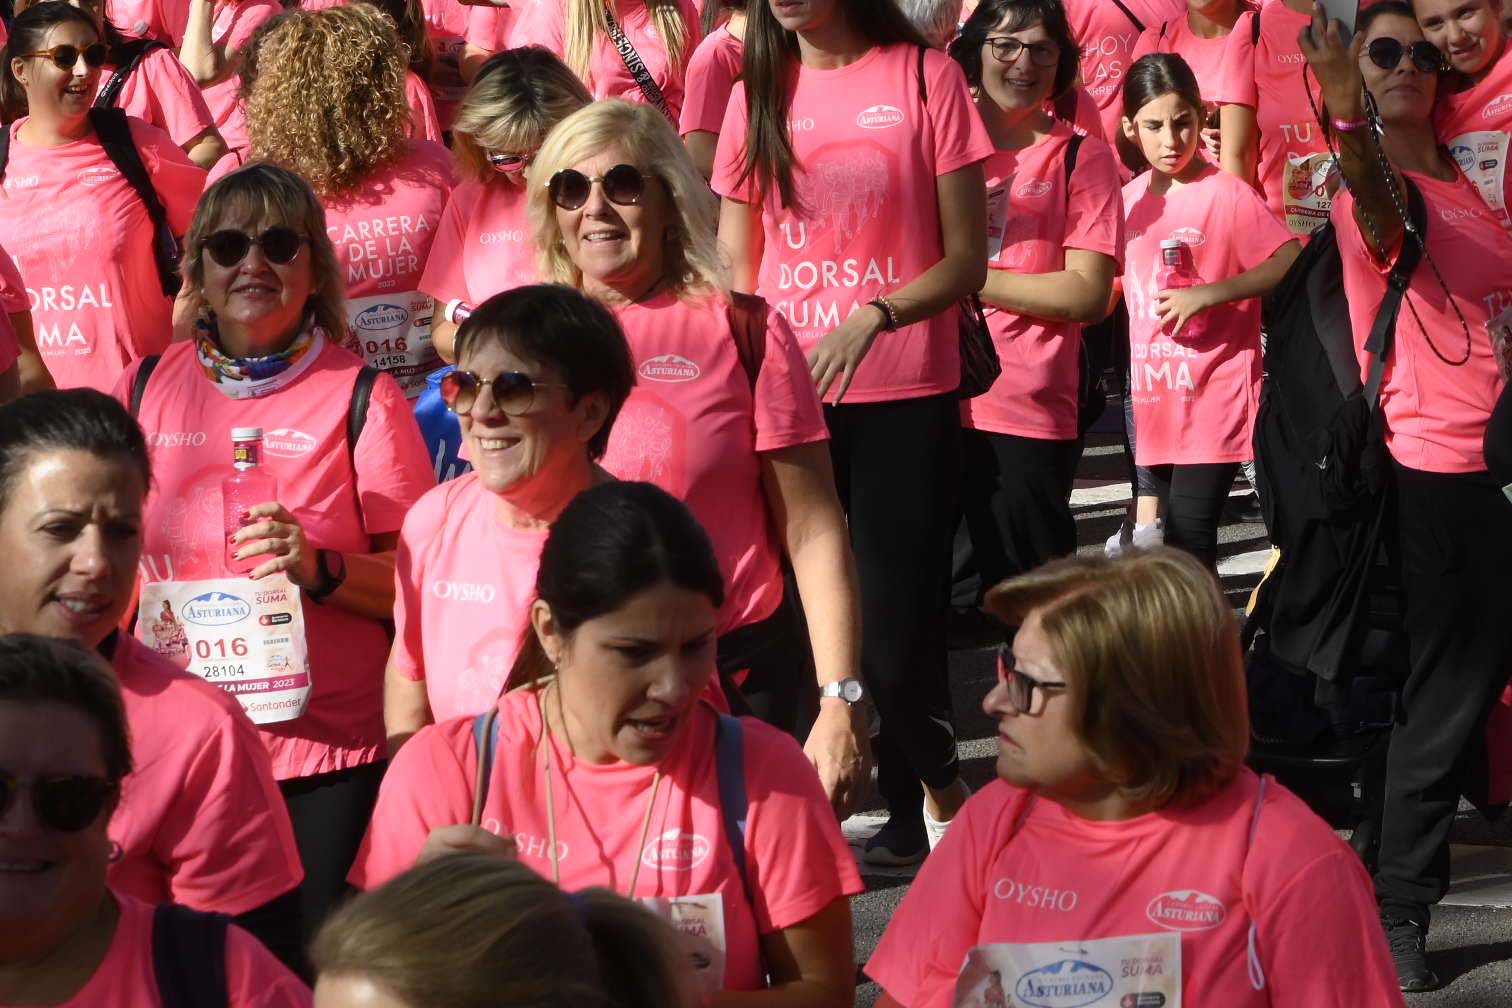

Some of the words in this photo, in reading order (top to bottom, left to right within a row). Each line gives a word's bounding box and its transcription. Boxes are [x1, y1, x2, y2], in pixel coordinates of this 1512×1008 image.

[1084, 33, 1132, 59] HOY
[1279, 123, 1312, 144] TU
[326, 214, 430, 245] CARRERA
[350, 242, 379, 263] DE
[387, 236, 414, 256] LA
[348, 255, 419, 283] MUJER
[778, 256, 901, 290] DORSAL
[358, 313, 406, 327] ASTURIANA
[366, 337, 408, 354] 016
[373, 354, 406, 369] 14158
[256, 594, 288, 605] SUMA
[433, 580, 496, 603] OYSHO
[188, 604, 247, 620] ASTURIANA
[196, 637, 248, 659] 016
[203, 664, 245, 679] 28104
[224, 683, 237, 692] LA
[237, 681, 270, 691] MUJER
[272, 678, 295, 689] 2023
[250, 697, 302, 712] Santander
[483, 817, 570, 863] OSHO
[994, 877, 1079, 912] OYSHO
[1154, 900, 1222, 923] ASTURIANA
[1023, 979, 1106, 998] ASTURIANA
